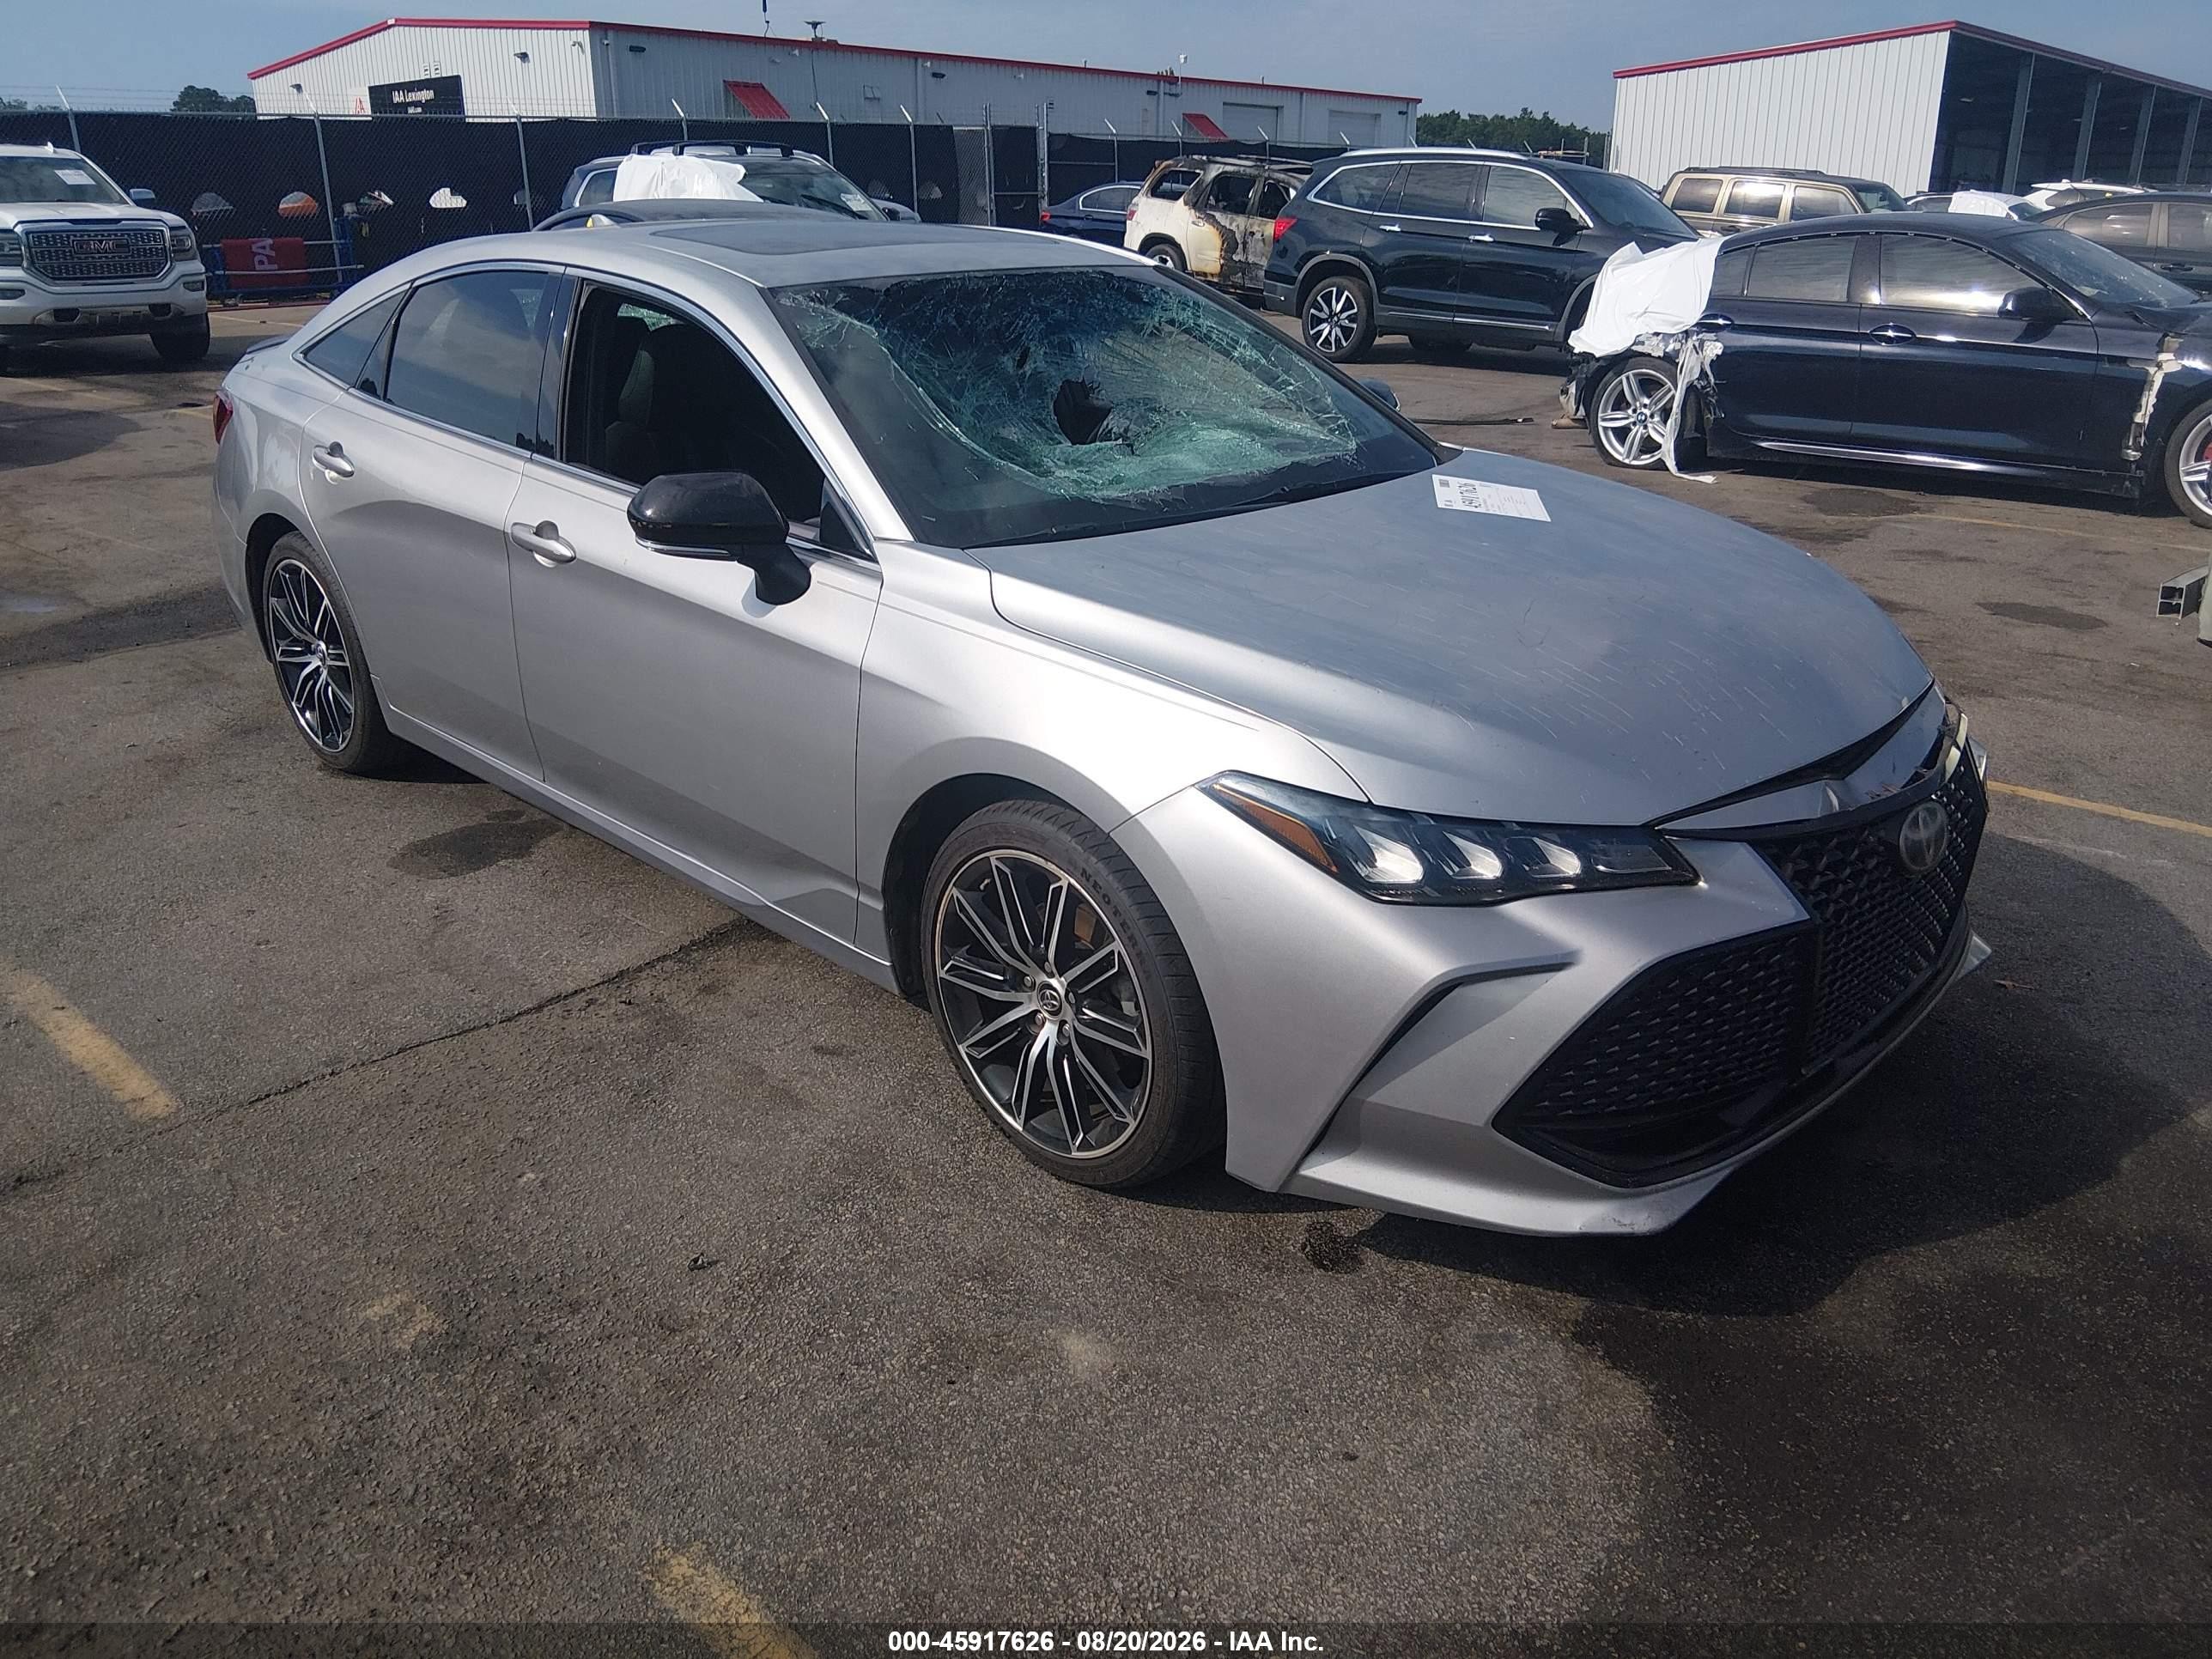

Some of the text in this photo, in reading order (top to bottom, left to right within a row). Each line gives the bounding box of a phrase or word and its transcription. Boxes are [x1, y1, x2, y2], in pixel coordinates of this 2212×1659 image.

[392, 88, 434, 104] IAA Lexington
[76, 240, 129, 253] GMC
[251, 236, 278, 270] PA
